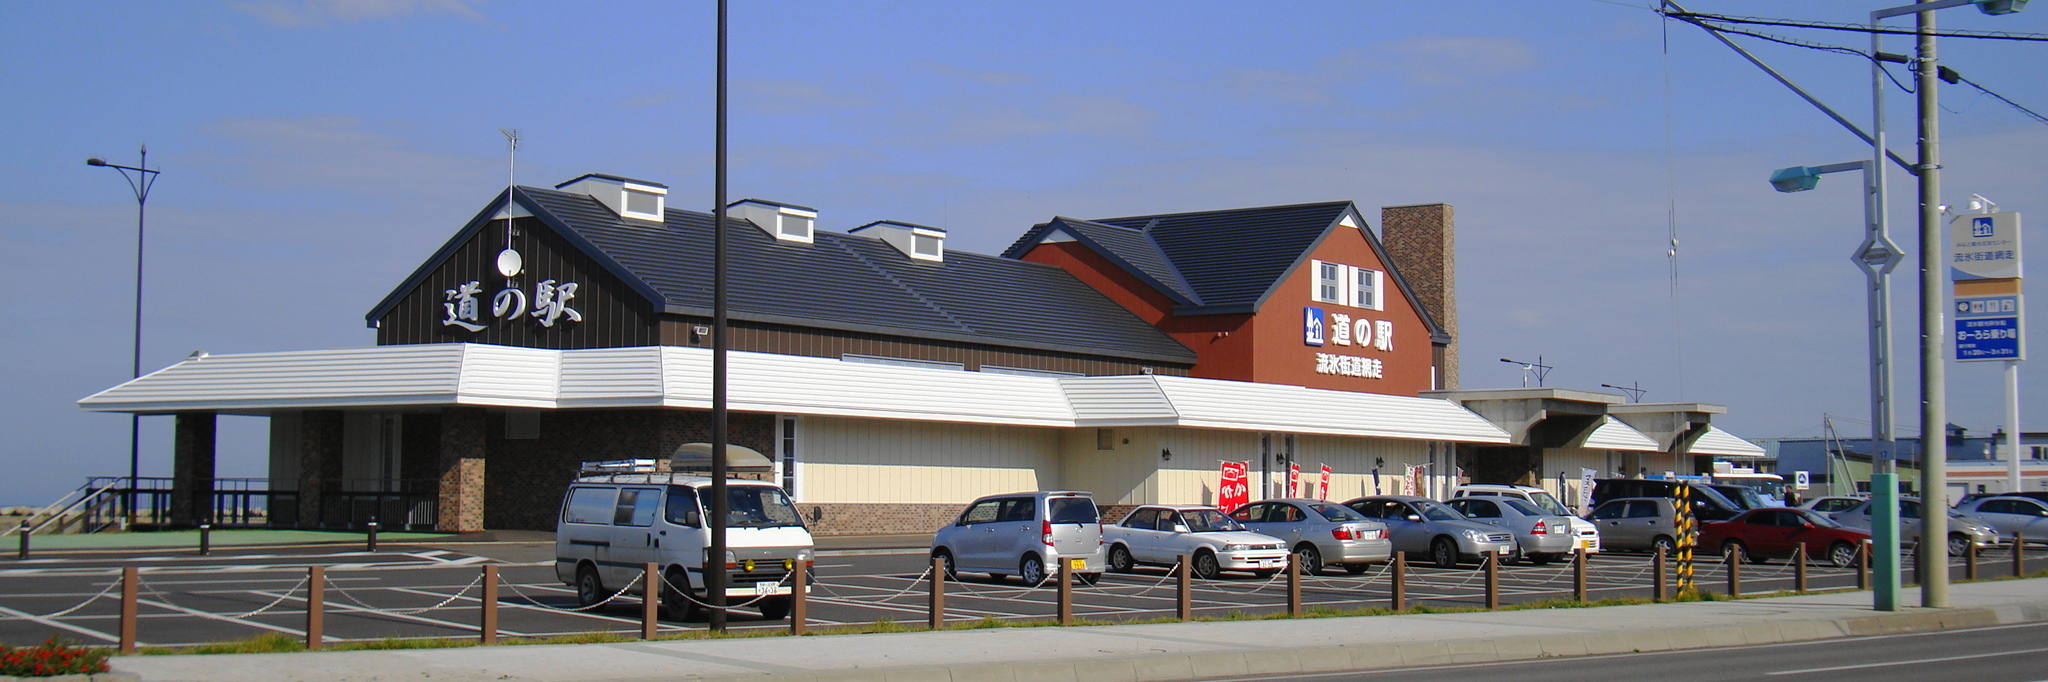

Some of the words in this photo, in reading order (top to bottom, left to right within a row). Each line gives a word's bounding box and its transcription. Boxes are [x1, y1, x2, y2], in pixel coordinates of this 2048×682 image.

[442, 279, 583, 332] 道の駅
[1331, 313, 1394, 352] 道の駅
[1315, 352, 1383, 379] 流氷街道網走
